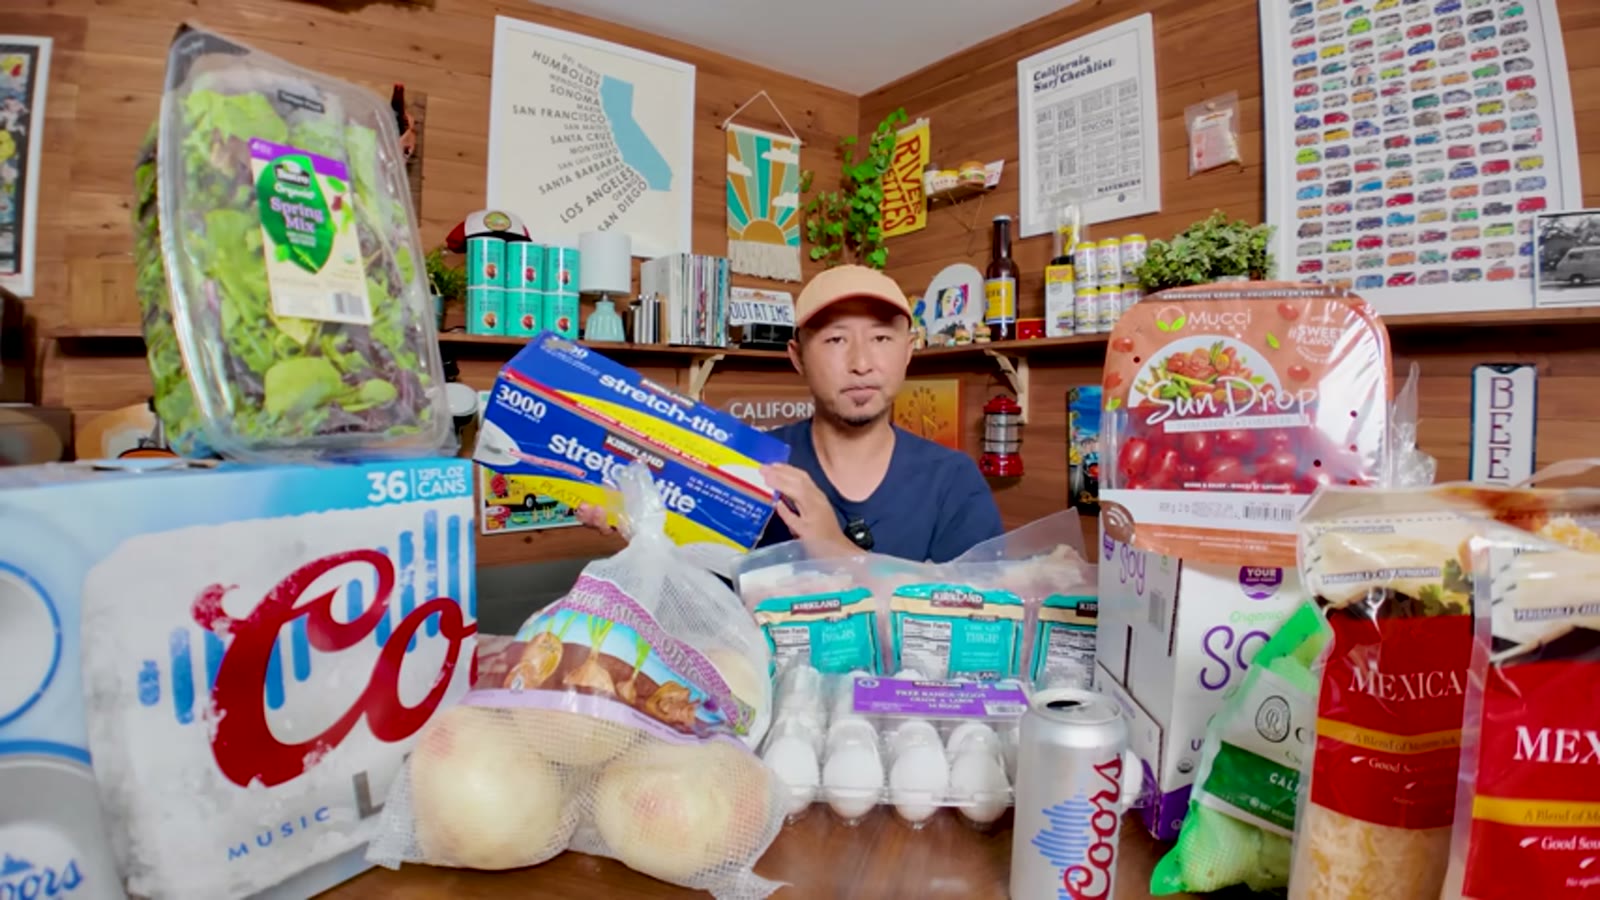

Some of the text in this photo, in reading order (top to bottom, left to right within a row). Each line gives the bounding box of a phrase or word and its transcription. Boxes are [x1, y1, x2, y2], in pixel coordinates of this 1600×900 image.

[531, 50, 600, 90] HUMBOLDT
[1033, 53, 1091, 83] California
[1033, 74, 1058, 93] Surf
[549, 83, 601, 107] SONOMA
[512, 104, 607, 124] SAN FRANCISCO
[550, 131, 612, 145] SANTA CRUZ
[538, 154, 621, 196] SANTA BARBARA
[893, 135, 922, 214] RIVER
[269, 196, 325, 224] Spring
[559, 165, 635, 225] LOS ANGELES
[616, 179, 648, 214] DIEGO
[285, 215, 317, 234] Mix
[729, 301, 794, 324] OUTATIME
[1188, 308, 1252, 327] Mucci
[495, 383, 547, 419] 3000
[598, 373, 728, 443] stretch-tite
[1145, 375, 1319, 426] Sun Drop
[1487, 376, 1515, 480] BEE
[604, 434, 665, 470] KIRKLAND
[367, 470, 409, 503] 36
[417, 478, 467, 498] CANS
[1246, 568, 1277, 577] YOUR
[792, 599, 840, 612] KIRKLAND
[932, 589, 983, 604] KIRKLAND
[1347, 666, 1463, 702] MEXICA
[1512, 725, 1600, 765] MEX
[1368, 757, 1400, 774] Good
[352, 770, 386, 821] L
[1064, 753, 1124, 900] Coors
[1524, 808, 1534, 822] A
[1536, 807, 1572, 822] Blend
[227, 806, 332, 862] MUSIC
[1541, 835, 1577, 851] Good
